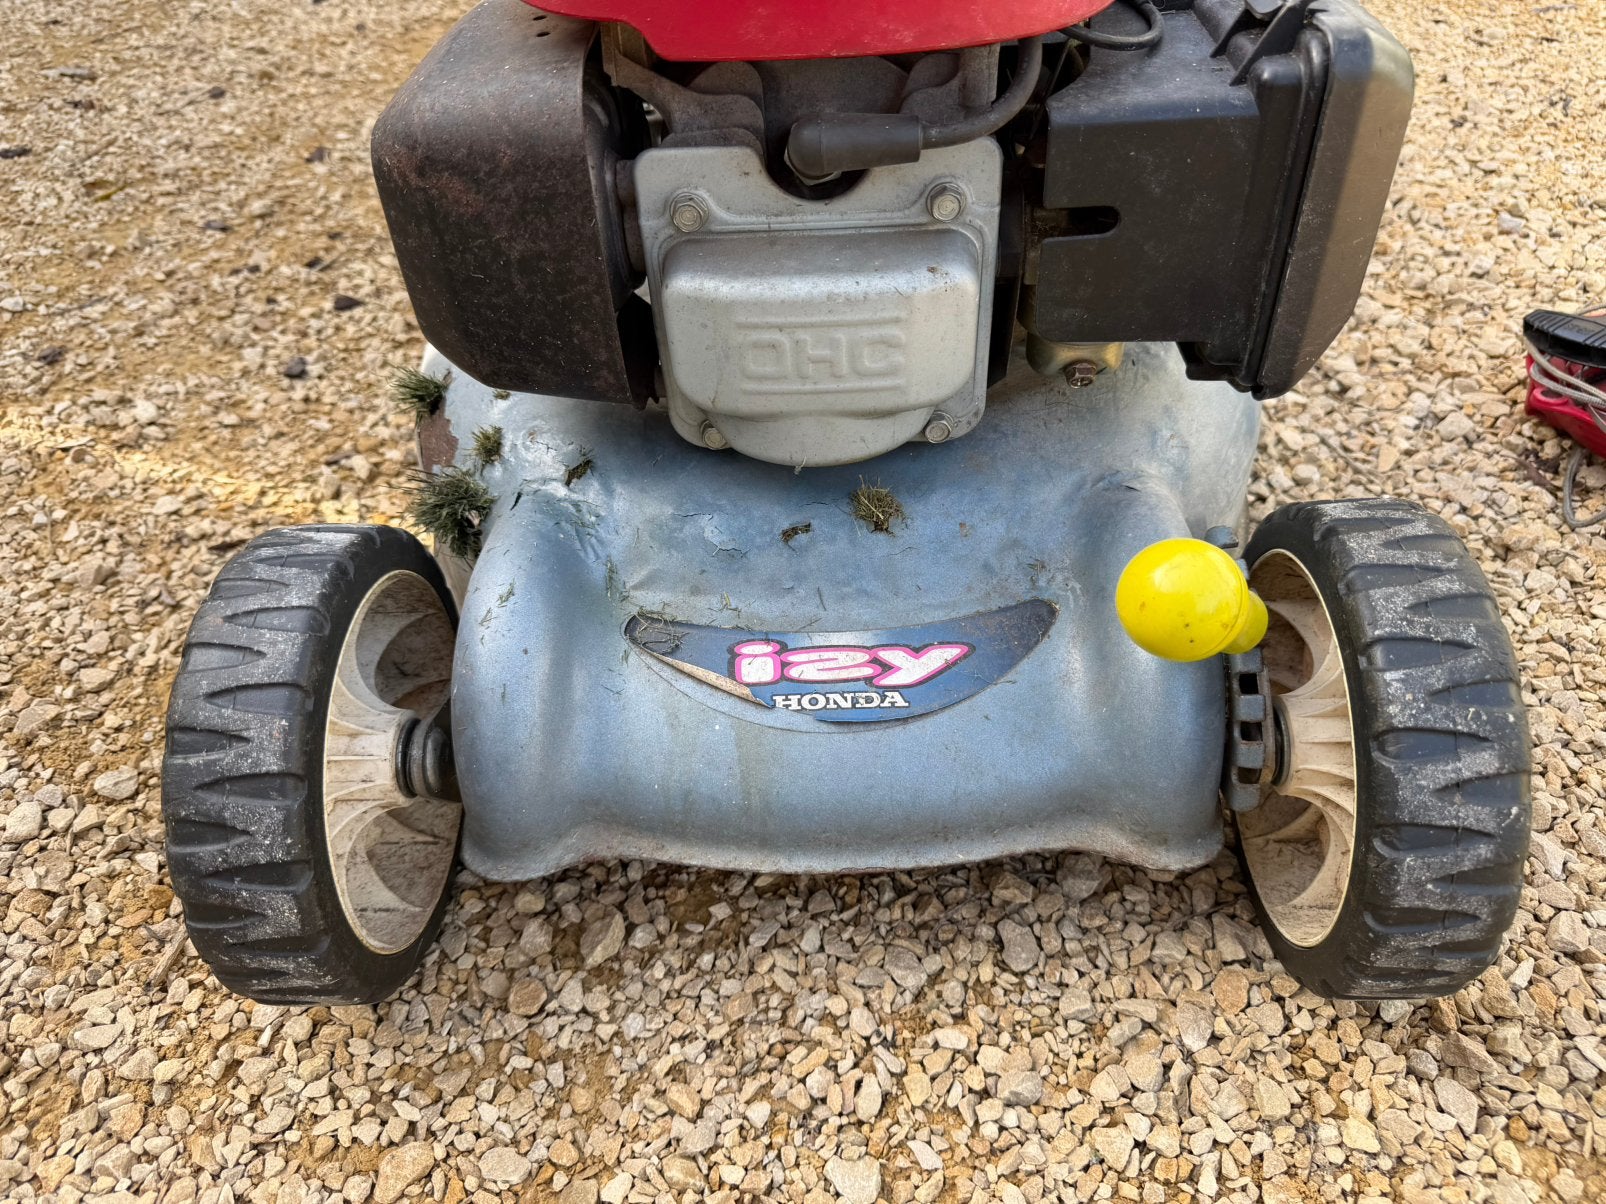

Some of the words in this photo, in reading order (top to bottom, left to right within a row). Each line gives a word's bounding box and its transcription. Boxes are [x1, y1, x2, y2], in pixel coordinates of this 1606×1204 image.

[742, 329, 906, 380] OHC
[734, 640, 969, 687] izy
[773, 691, 908, 711] HONDA
